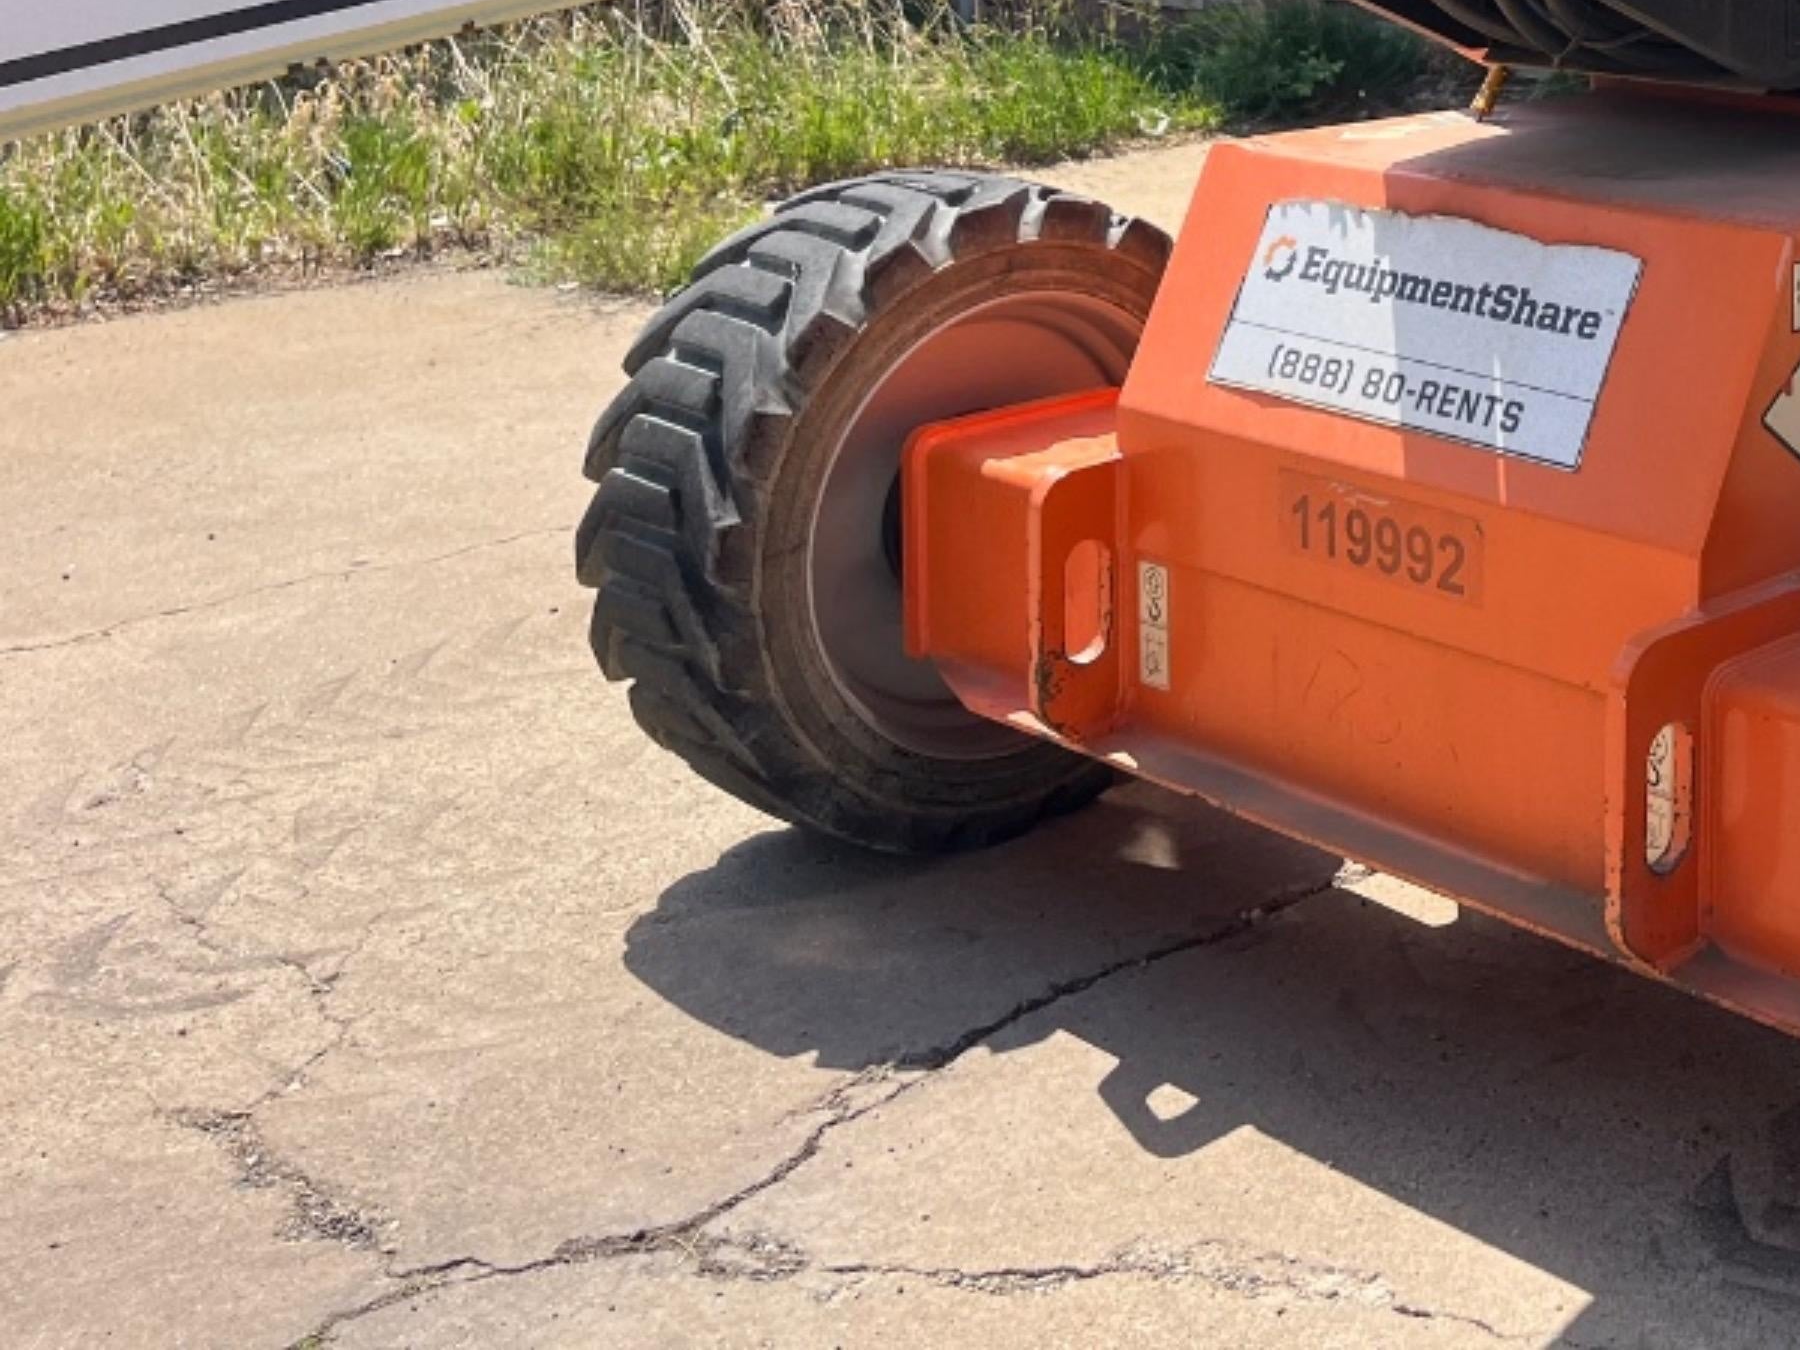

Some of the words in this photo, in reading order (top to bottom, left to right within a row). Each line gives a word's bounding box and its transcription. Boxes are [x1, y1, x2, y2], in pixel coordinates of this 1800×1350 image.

[1298, 245, 1602, 340] EquipmentShare
[1267, 342, 1354, 392] (888)
[1361, 366, 1525, 434] 80-RENTS
[1291, 494, 1465, 596] 119992
